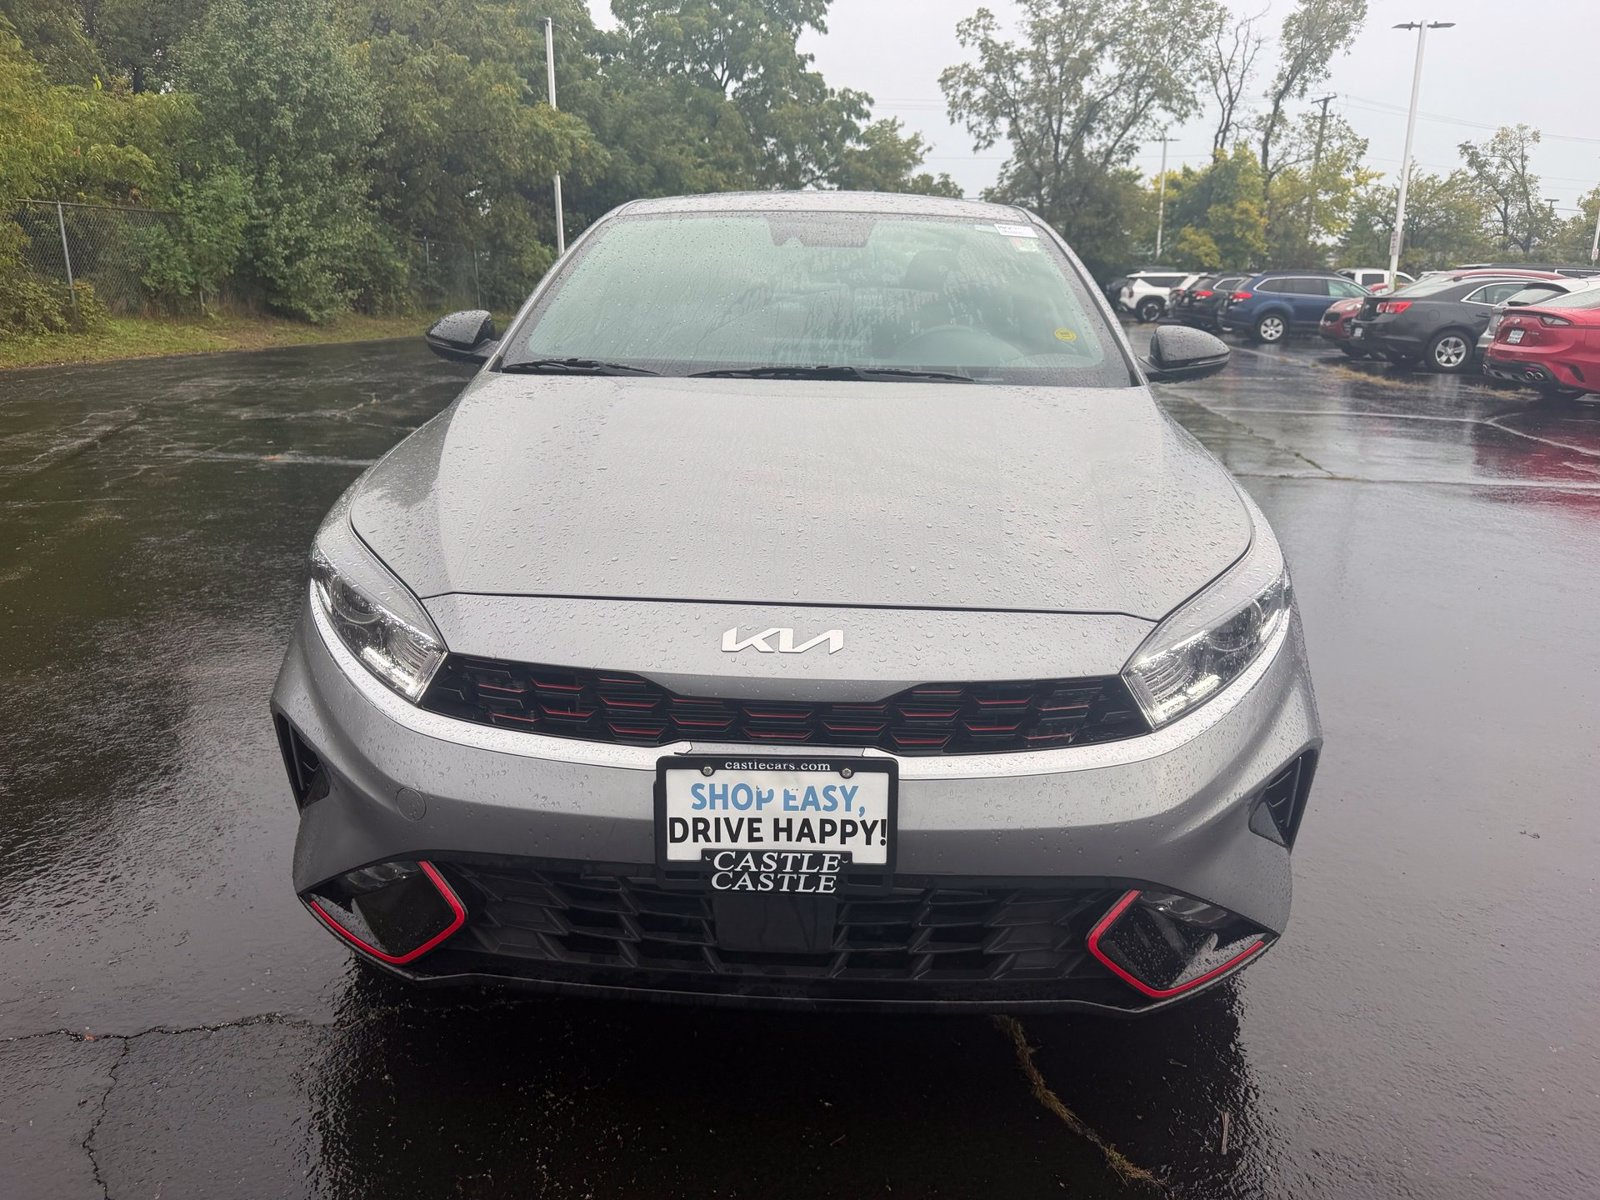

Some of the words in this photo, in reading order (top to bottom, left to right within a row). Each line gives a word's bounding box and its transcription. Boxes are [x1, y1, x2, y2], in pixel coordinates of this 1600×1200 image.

[724, 760, 831, 771] castlecars.com
[690, 782, 775, 811] SHOP
[783, 784, 866, 818] EASY,
[668, 816, 764, 844] DRIVE
[773, 817, 888, 847] HAPPY!
[713, 851, 842, 873] CASTLE
[711, 871, 837, 894] CASTLE
